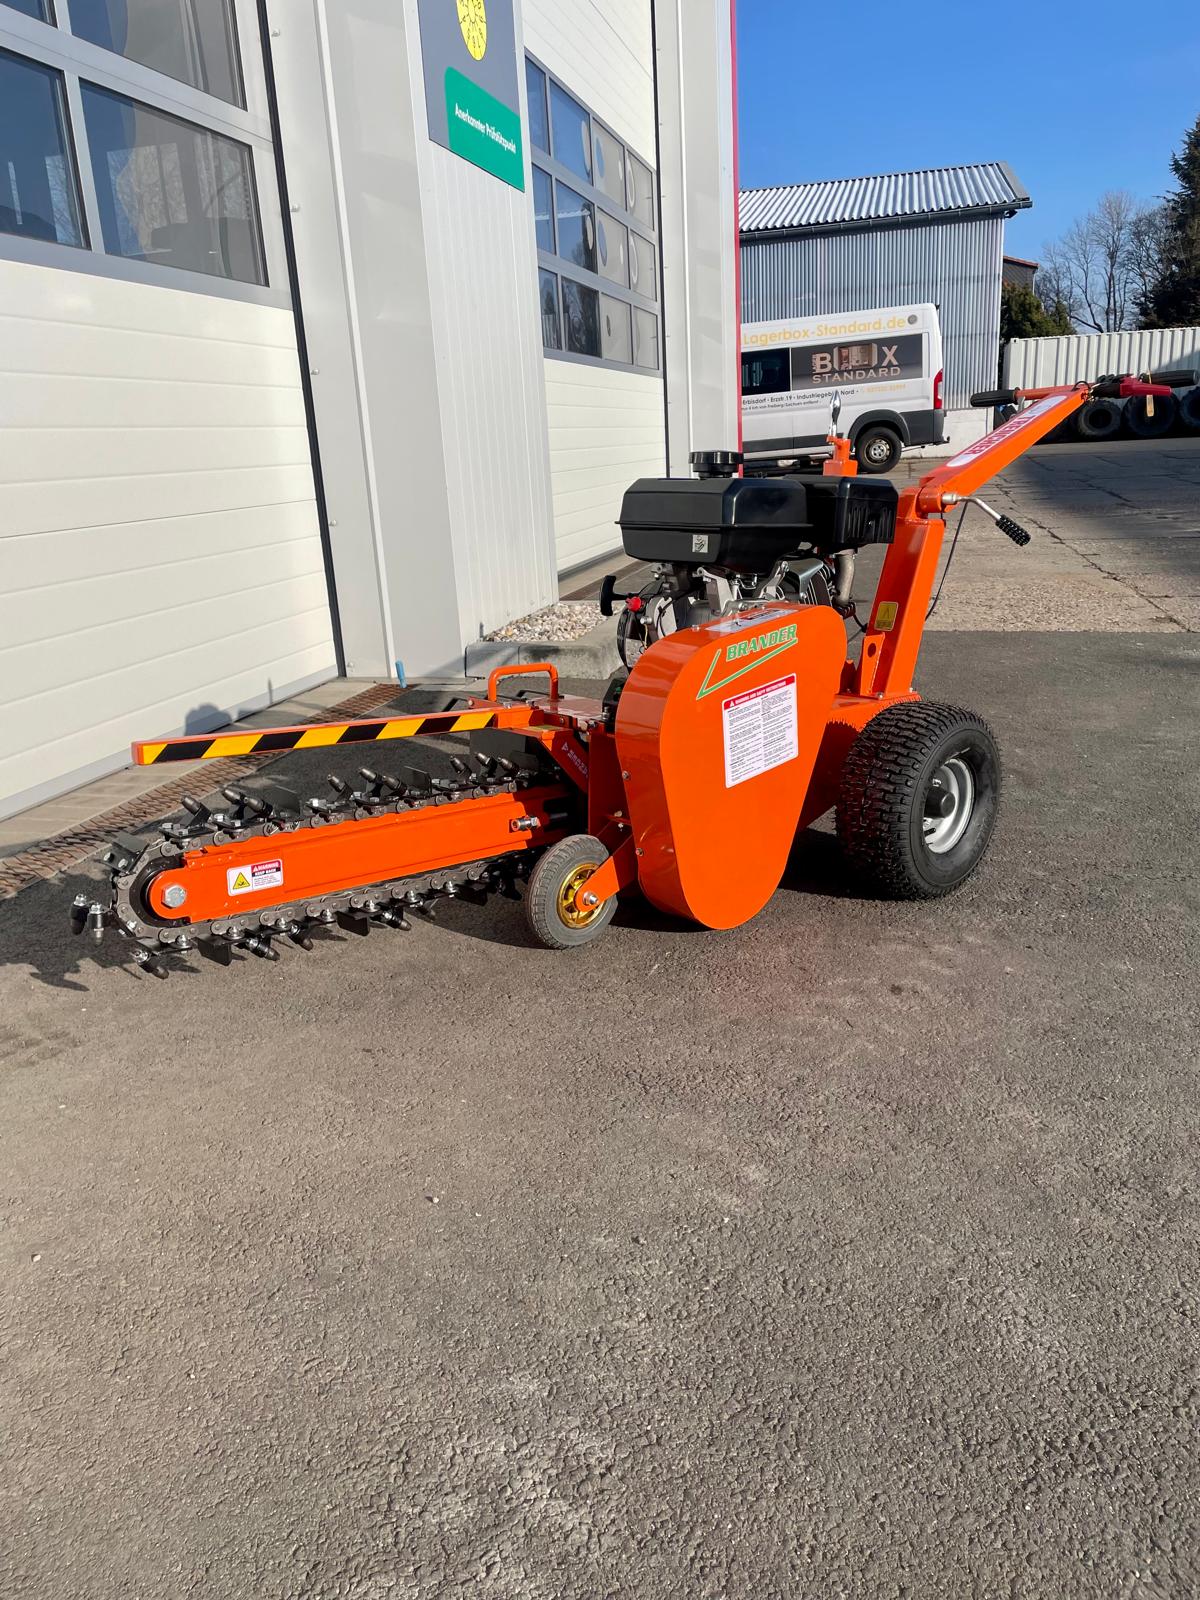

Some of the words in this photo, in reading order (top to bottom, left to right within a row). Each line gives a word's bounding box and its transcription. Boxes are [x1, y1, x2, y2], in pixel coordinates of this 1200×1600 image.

[743, 316, 906, 345] Lagerbox-Standard.de
[812, 366, 901, 384] STANDARD
[726, 624, 797, 662] BRANDER
